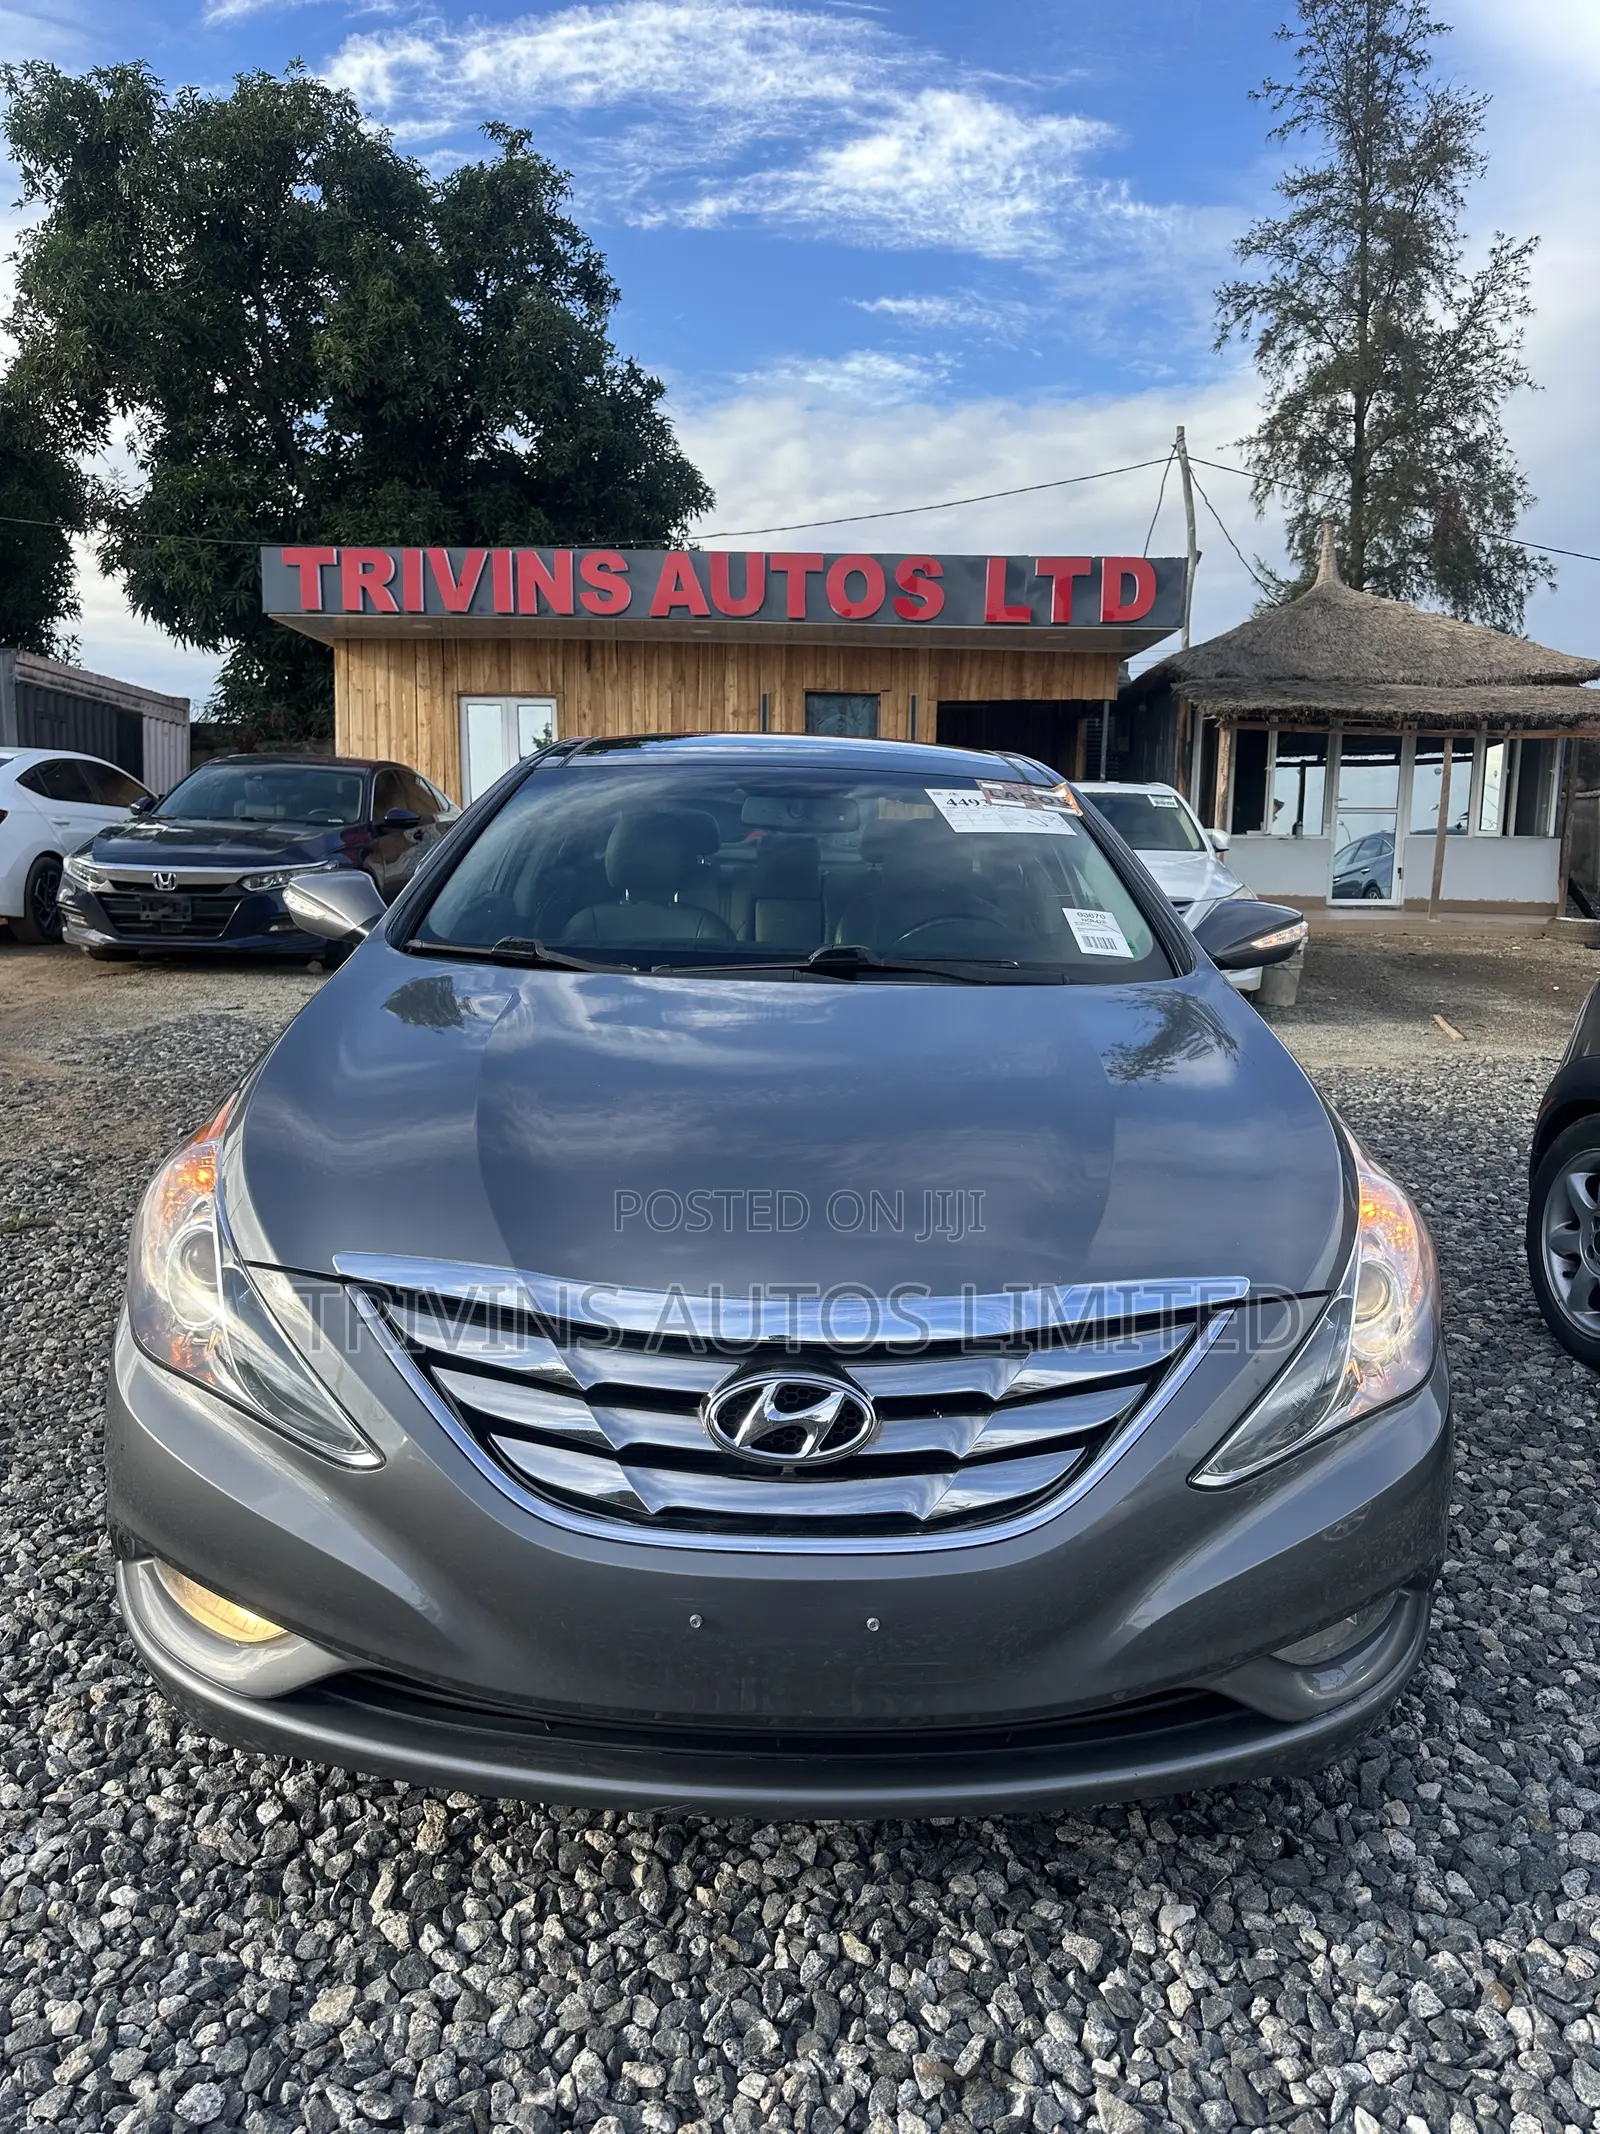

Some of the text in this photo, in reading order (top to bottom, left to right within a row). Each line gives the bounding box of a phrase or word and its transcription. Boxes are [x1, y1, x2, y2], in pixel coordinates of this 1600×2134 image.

[281, 547, 1157, 623] TRIVINS AUTOS LTD
